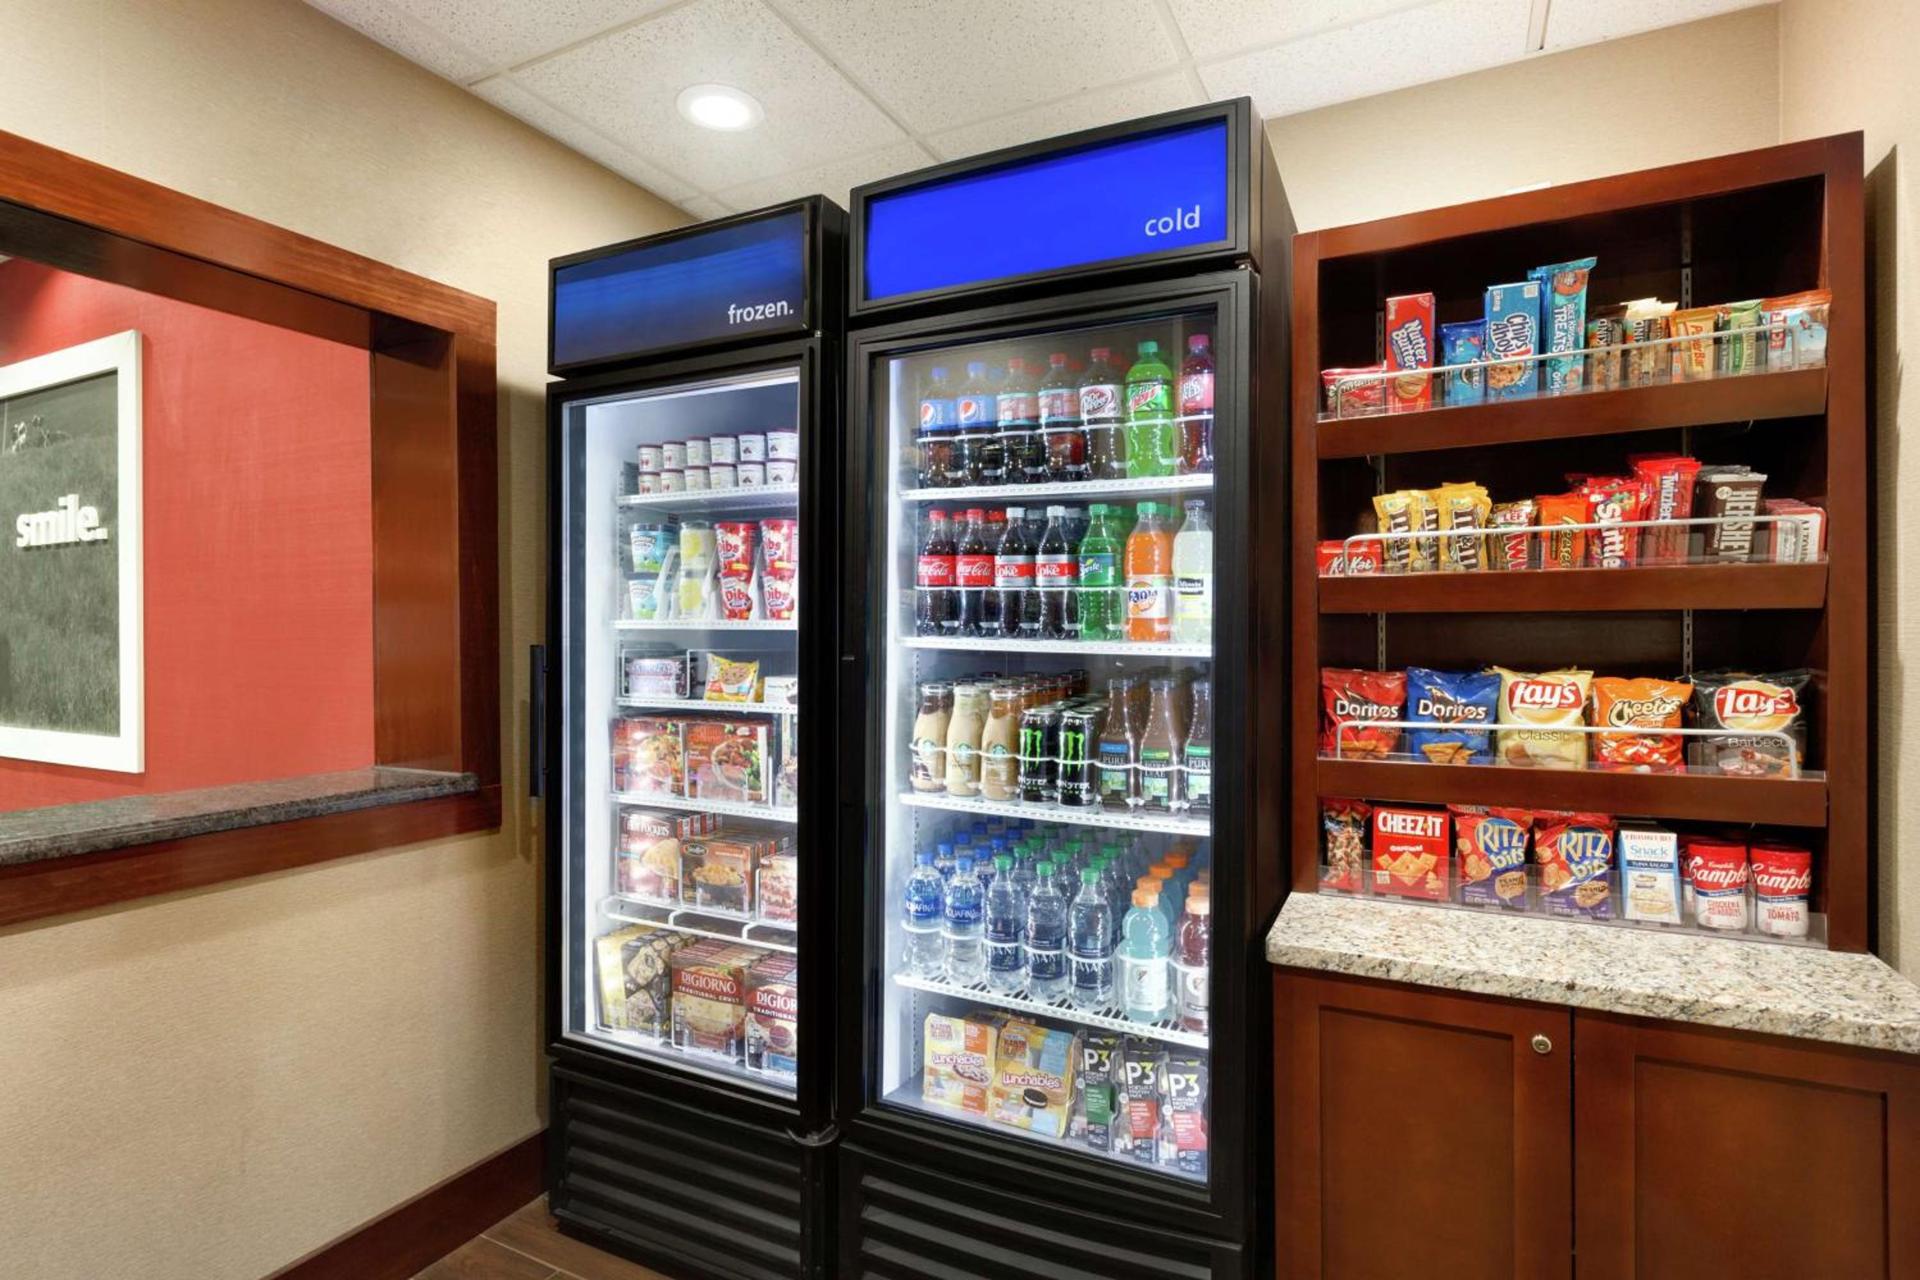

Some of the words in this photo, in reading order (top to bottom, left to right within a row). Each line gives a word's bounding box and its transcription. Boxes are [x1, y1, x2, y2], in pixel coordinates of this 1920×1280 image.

[1145, 205, 1201, 236] cold
[728, 301, 794, 325] frozen.
[1405, 319, 1427, 362] Nutter
[1506, 313, 1528, 349] Chips
[1552, 306, 1566, 353] TREATS
[1392, 329, 1417, 368] Butter
[16, 494, 108, 547] smile.
[1336, 700, 1399, 718] Doritos
[1418, 699, 1487, 719] Doritos
[1610, 698, 1682, 727] Cheetos
[1479, 823, 1525, 853] RITZ
[1560, 831, 1607, 862] RITZ
[1630, 844, 1669, 857] Snack
[1490, 849, 1525, 869] bits
[1767, 908, 1800, 922] TOMATO
[1083, 1048, 1111, 1072] P3
[1002, 1072, 1062, 1088] Lunchables
[1126, 1062, 1155, 1085] P3
[1169, 1073, 1200, 1098] P3
